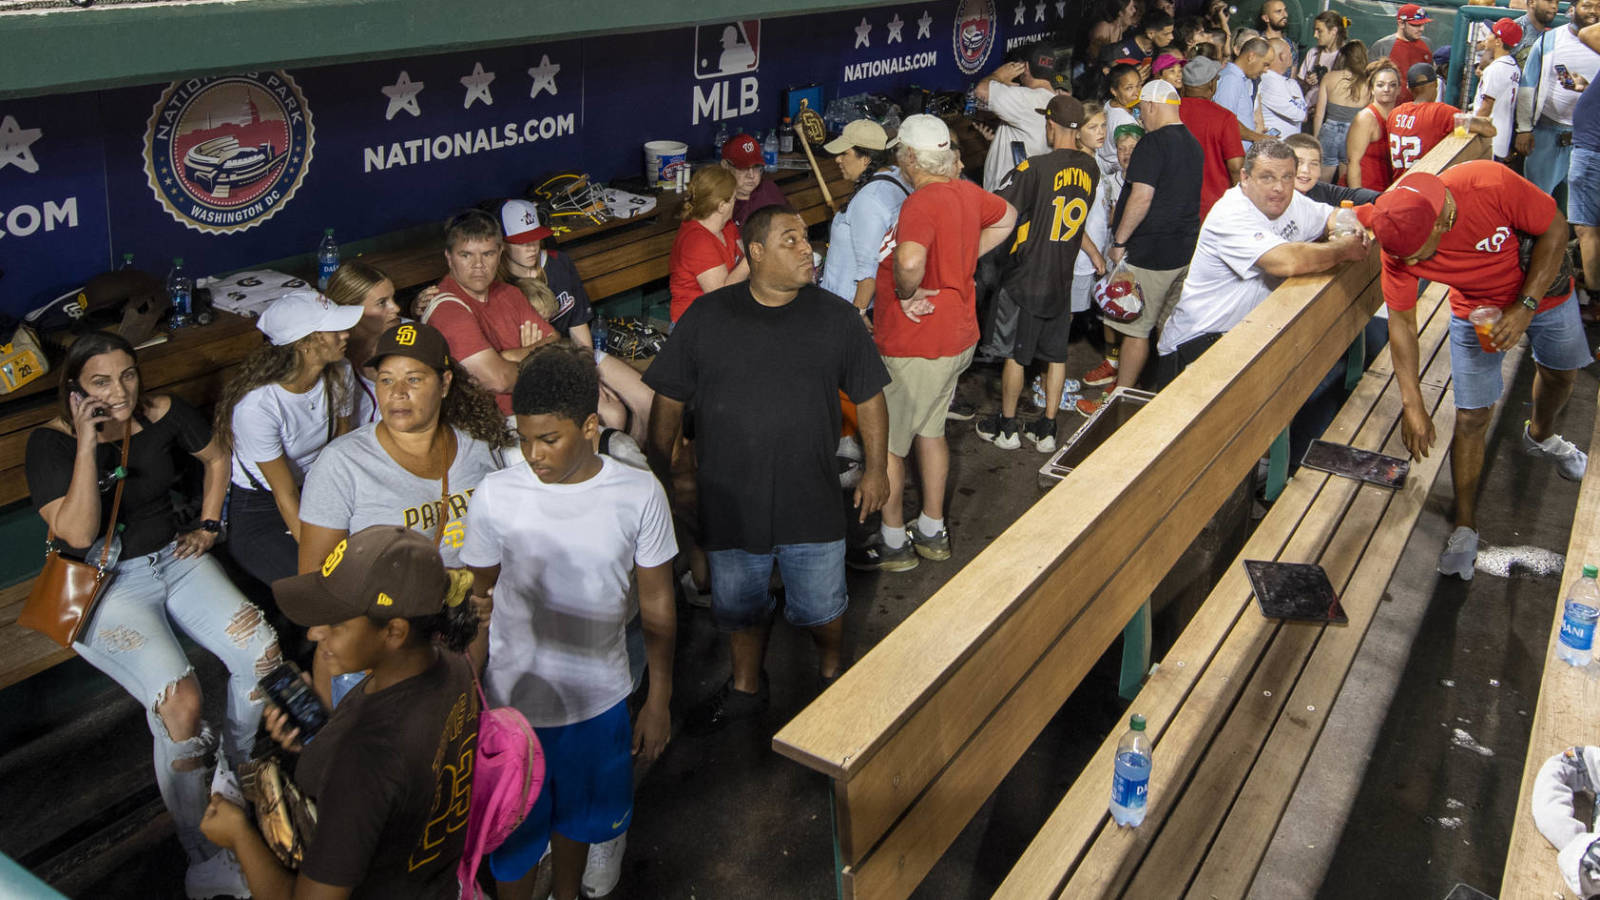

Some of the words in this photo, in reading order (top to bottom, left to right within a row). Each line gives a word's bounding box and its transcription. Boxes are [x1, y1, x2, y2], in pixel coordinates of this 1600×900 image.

[844, 51, 937, 82] NATIONALS.COM
[266, 75, 303, 125] PARK
[692, 77, 760, 125] MLB
[363, 112, 575, 173] NATIONALS.COM
[1389, 133, 1422, 169] 22
[1053, 167, 1092, 197] GWYNN
[0, 196, 79, 239] OM
[190, 203, 264, 223] WASHINGTON
[265, 190, 281, 207] DC
[1049, 195, 1088, 242] 19
[395, 325, 418, 346] SD
